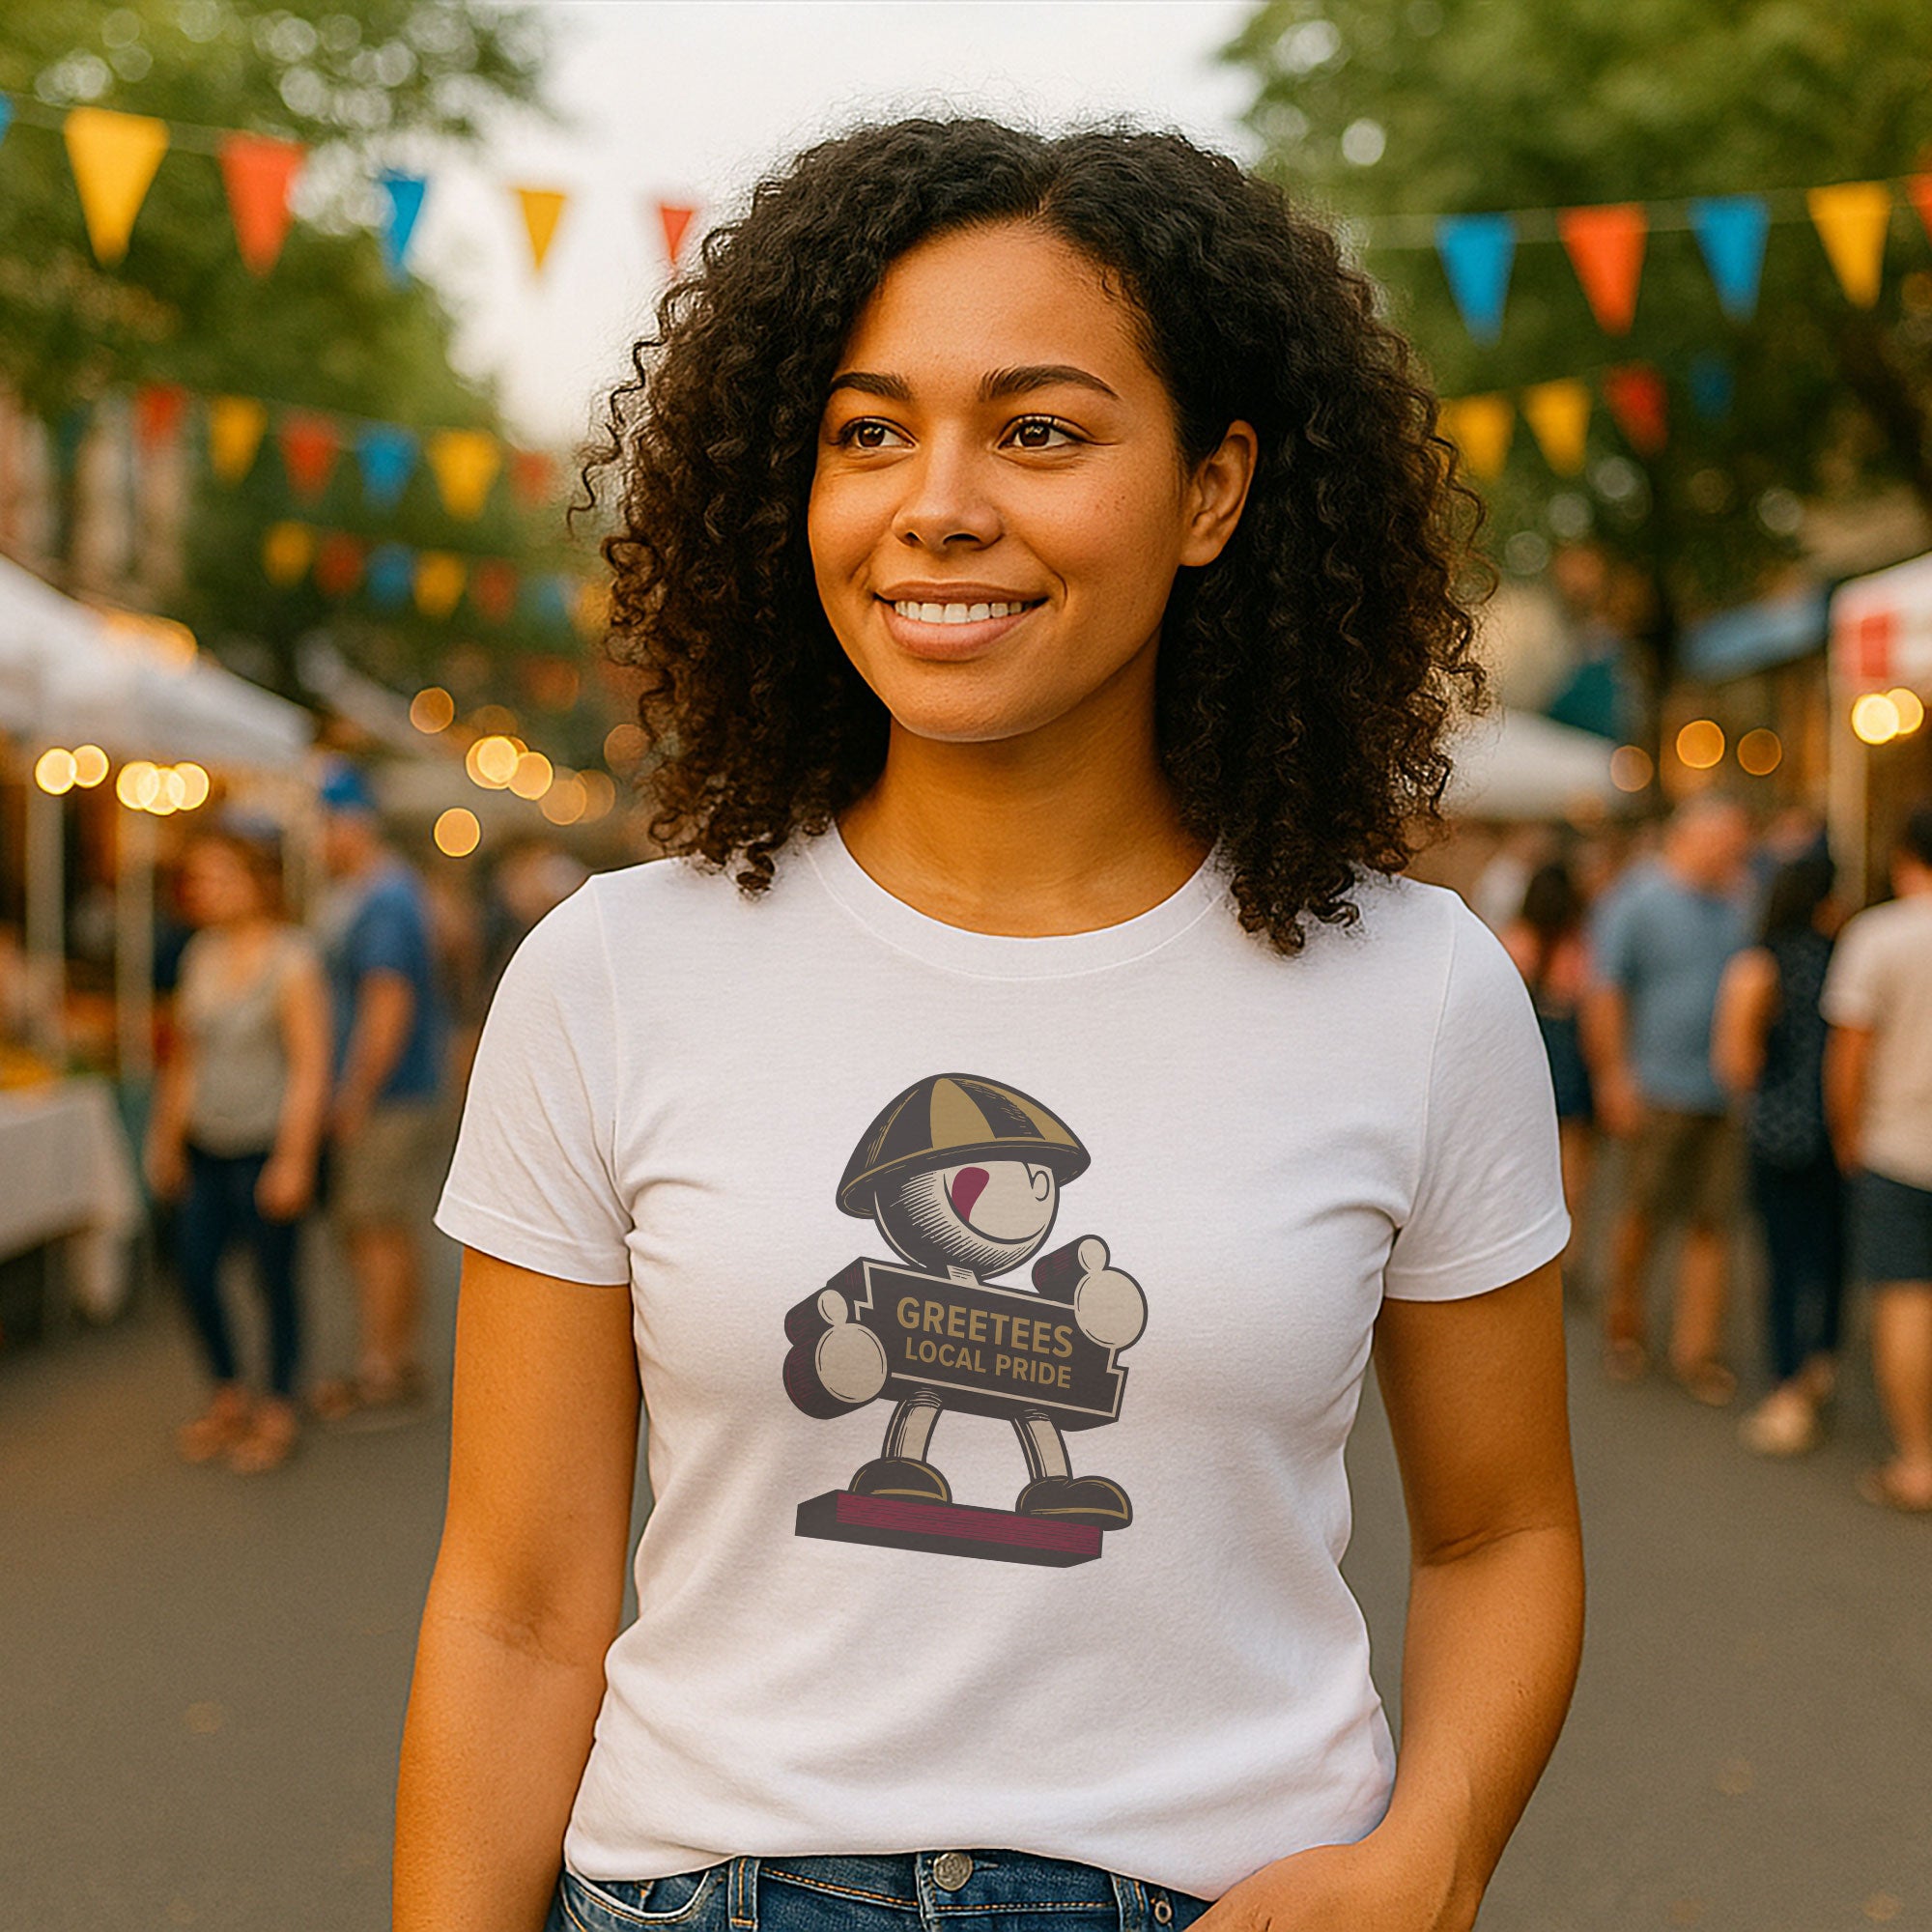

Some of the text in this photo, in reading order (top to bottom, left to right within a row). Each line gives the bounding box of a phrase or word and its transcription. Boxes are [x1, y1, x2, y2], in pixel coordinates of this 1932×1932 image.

[896, 1296, 1073, 1358] GREETEES
[905, 1337, 1071, 1389] LOCAL PRIDE
